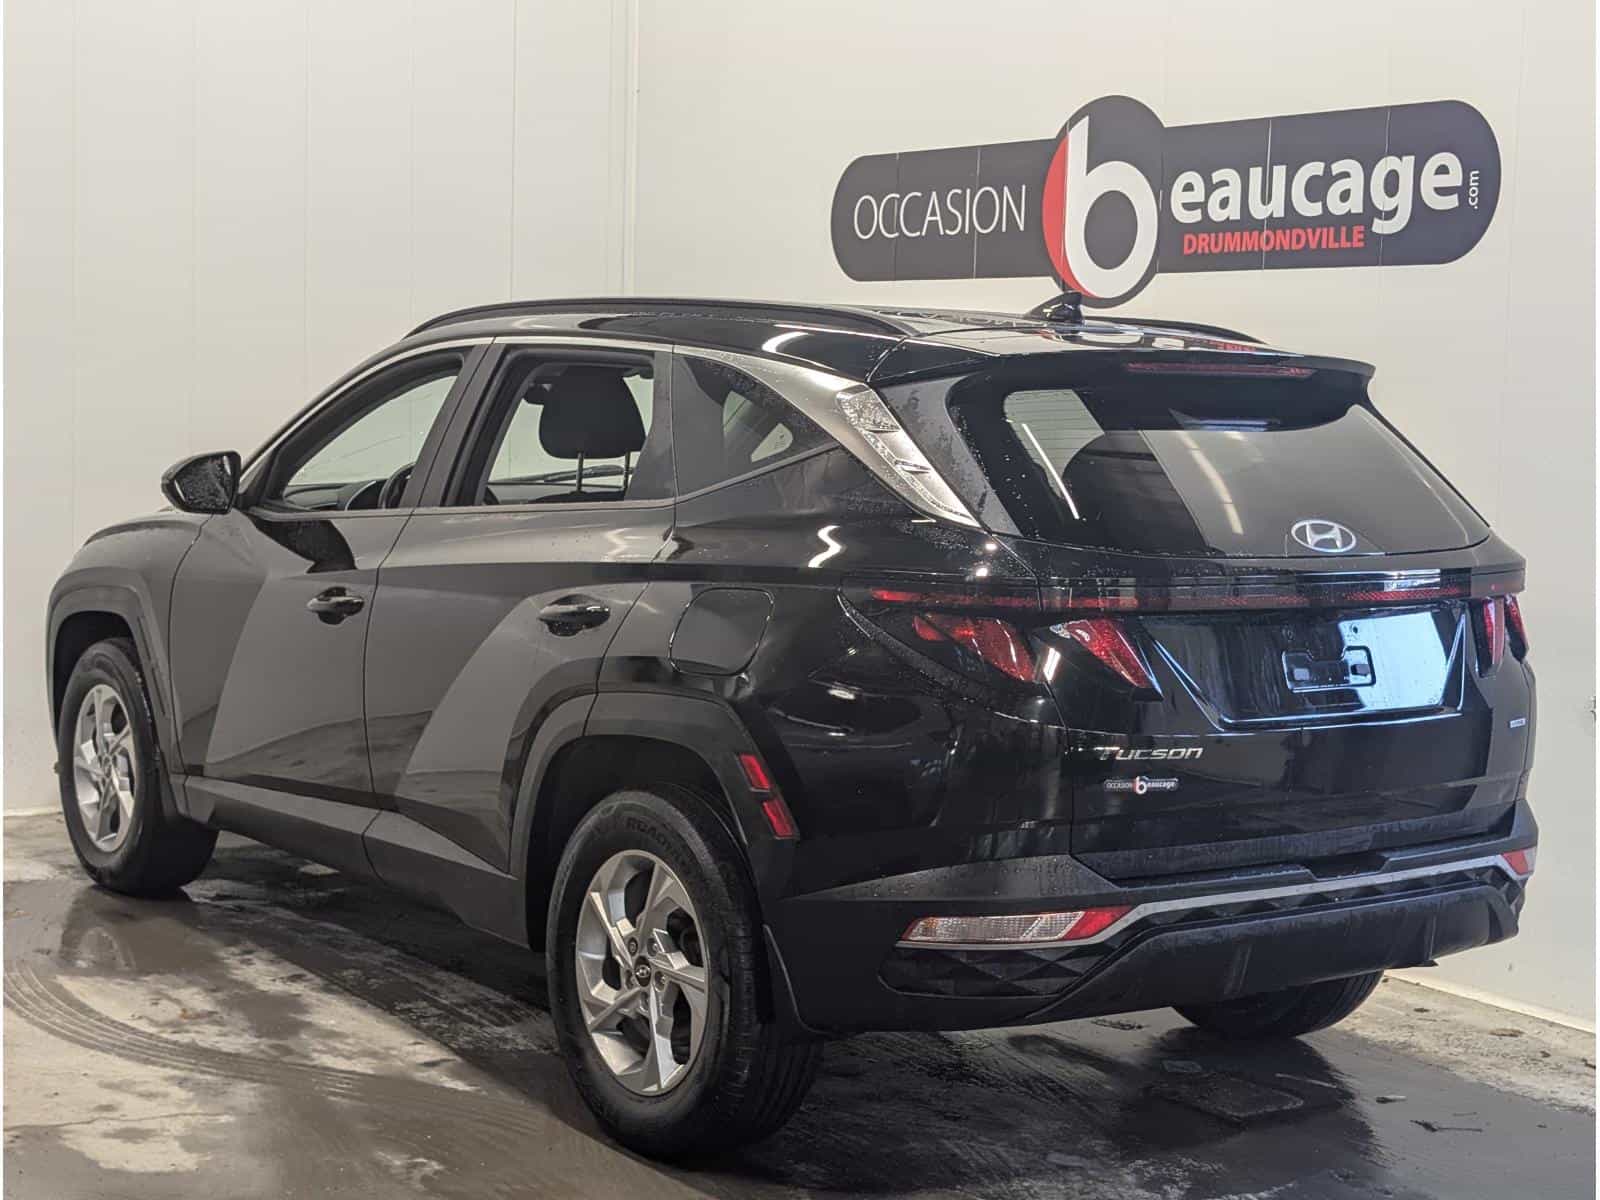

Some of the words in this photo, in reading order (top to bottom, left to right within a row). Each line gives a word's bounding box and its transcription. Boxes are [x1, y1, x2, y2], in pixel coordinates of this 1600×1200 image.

[852, 184, 1027, 241] OCCASION
[1467, 169, 1481, 211] .com
[1182, 225, 1366, 256] DRUMMONDVILLE
